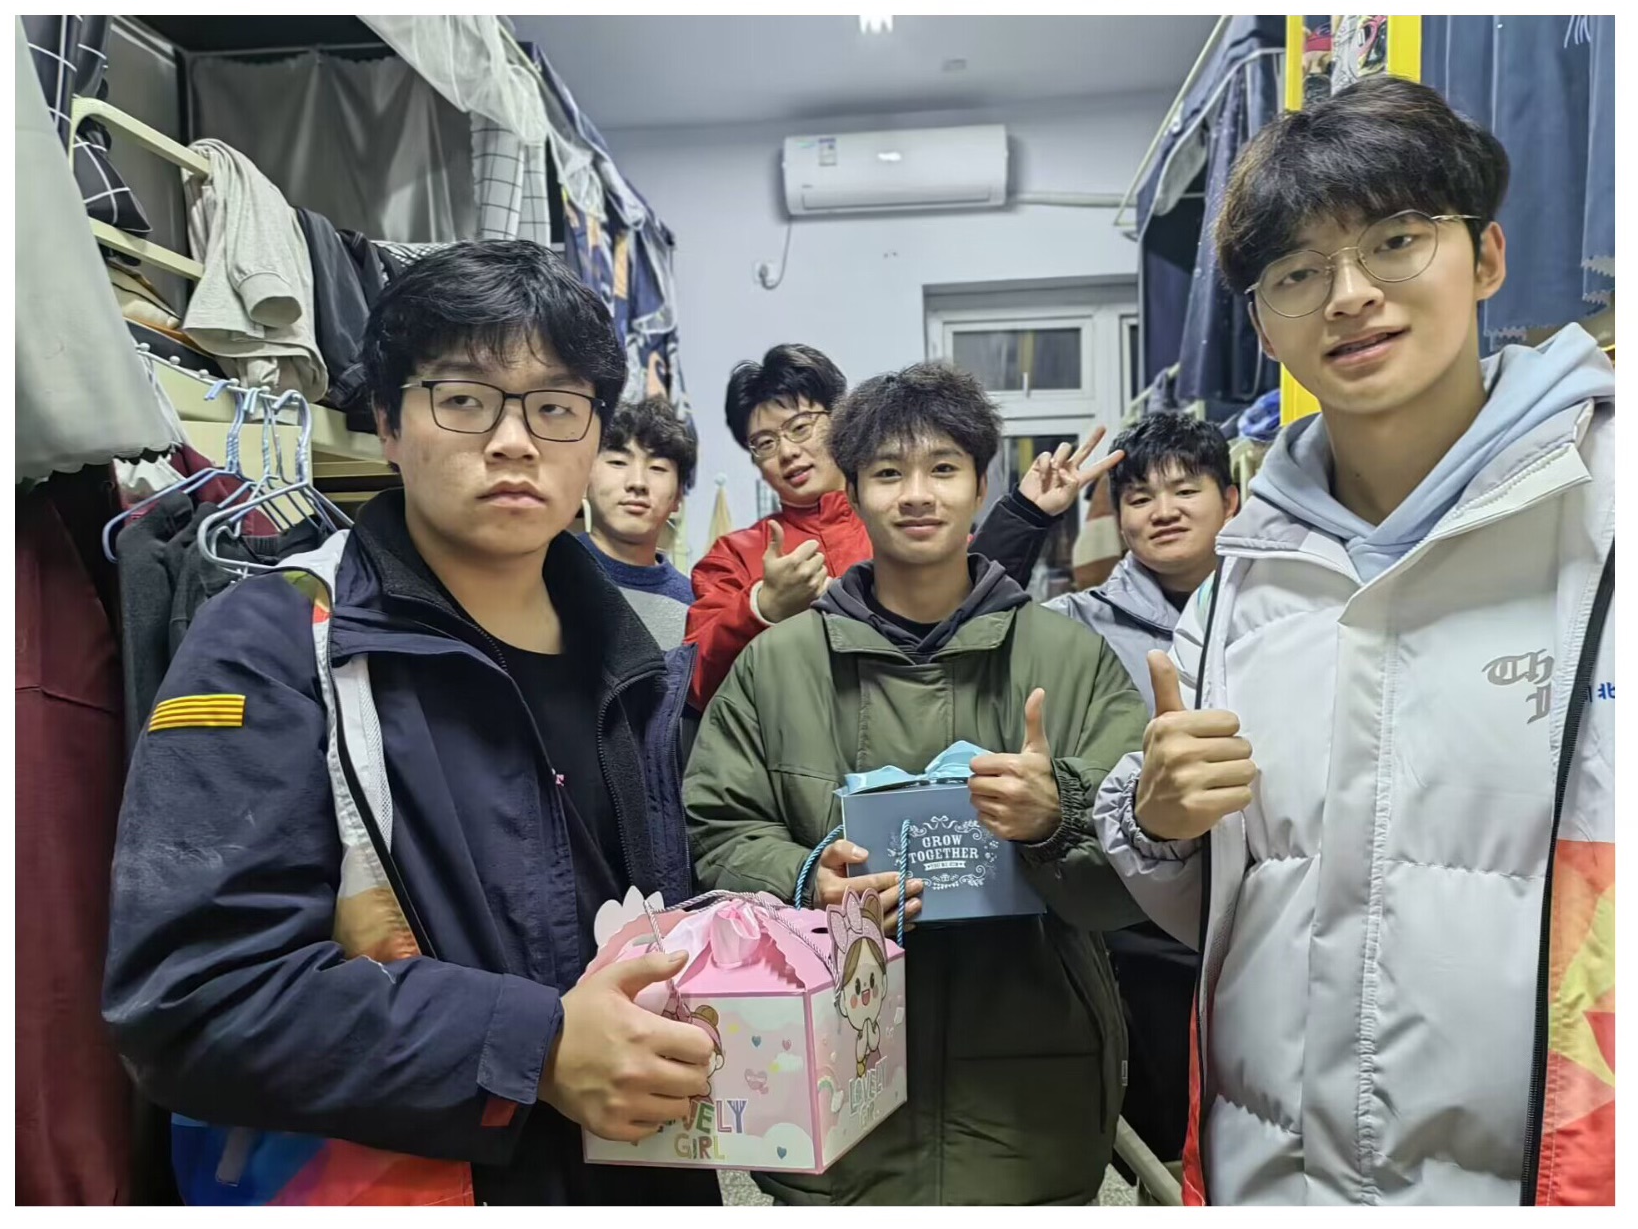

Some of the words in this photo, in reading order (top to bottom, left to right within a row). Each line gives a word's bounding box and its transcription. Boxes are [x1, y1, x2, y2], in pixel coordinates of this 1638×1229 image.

[922, 834, 962, 849] GROW
[908, 847, 980, 864] TOGETHER
[674, 1133, 726, 1160] GIRL
